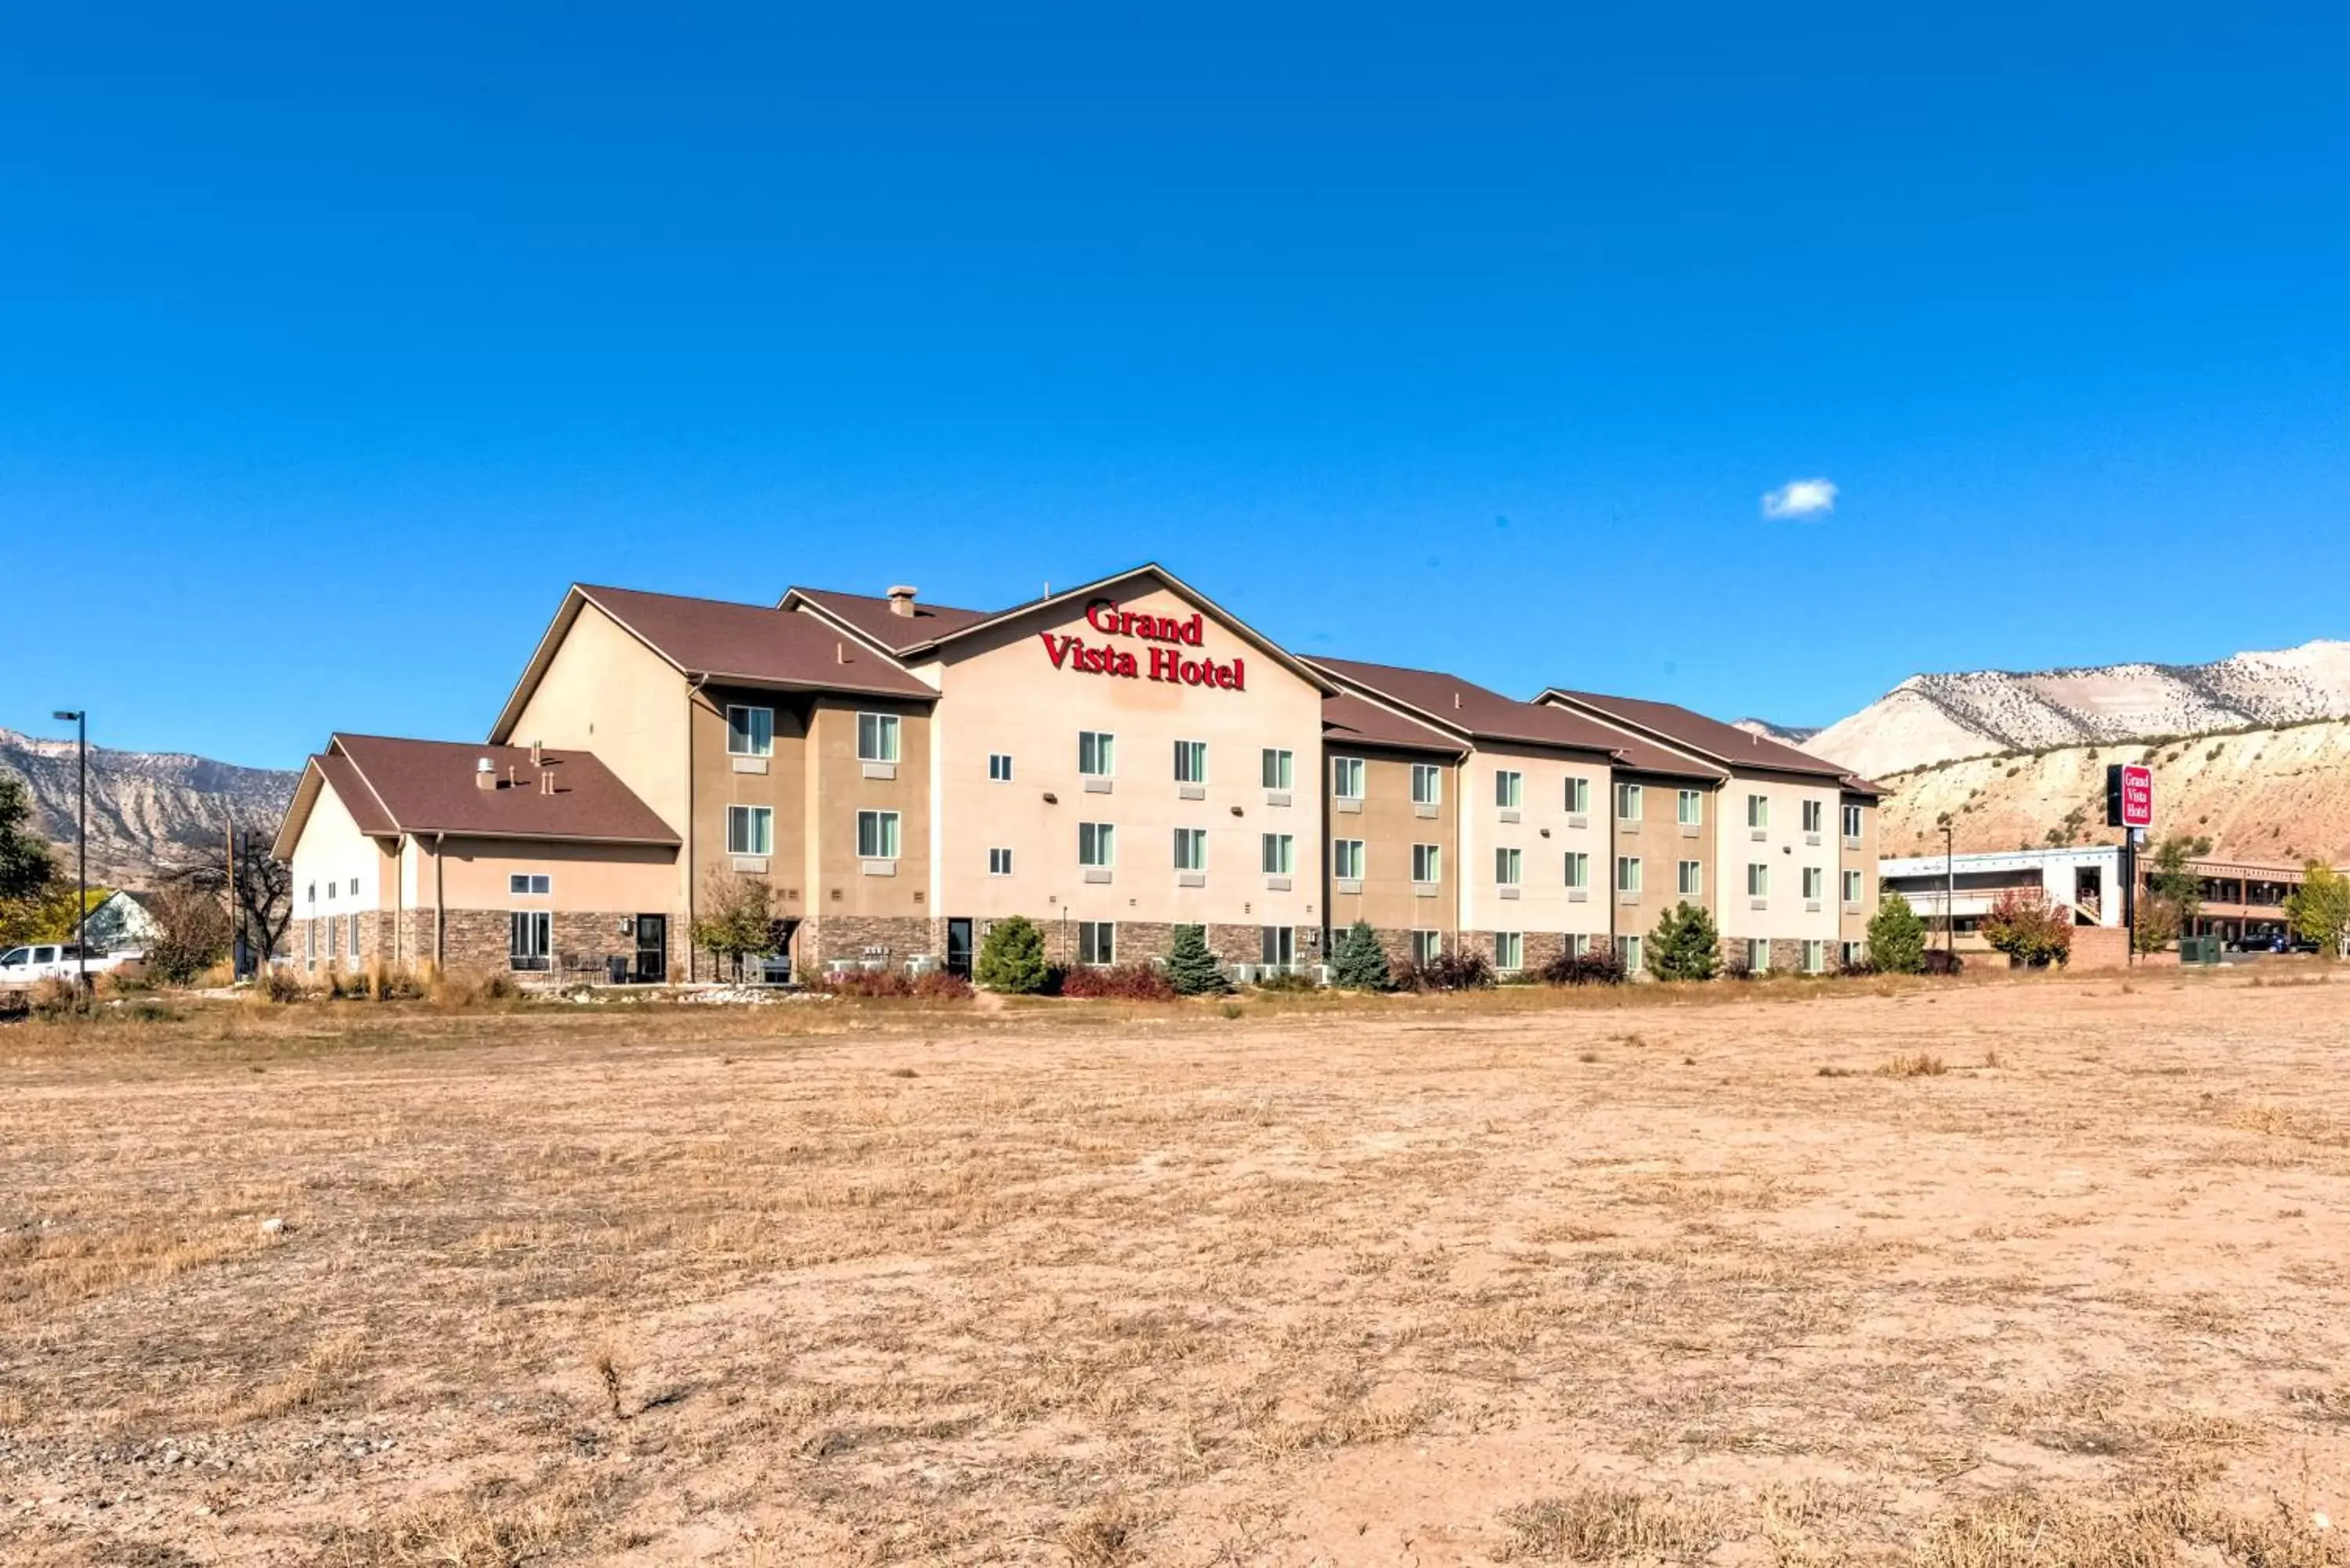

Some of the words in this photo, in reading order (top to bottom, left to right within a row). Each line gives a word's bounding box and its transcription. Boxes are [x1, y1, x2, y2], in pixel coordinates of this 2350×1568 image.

[1086, 598, 1204, 647] Grand
[1038, 631, 1139, 679] Vista
[1148, 647, 1246, 692] Hotel
[2125, 771, 2149, 787] Grand
[2127, 788, 2147, 803] Vista
[2127, 803, 2149, 818] Hotel
